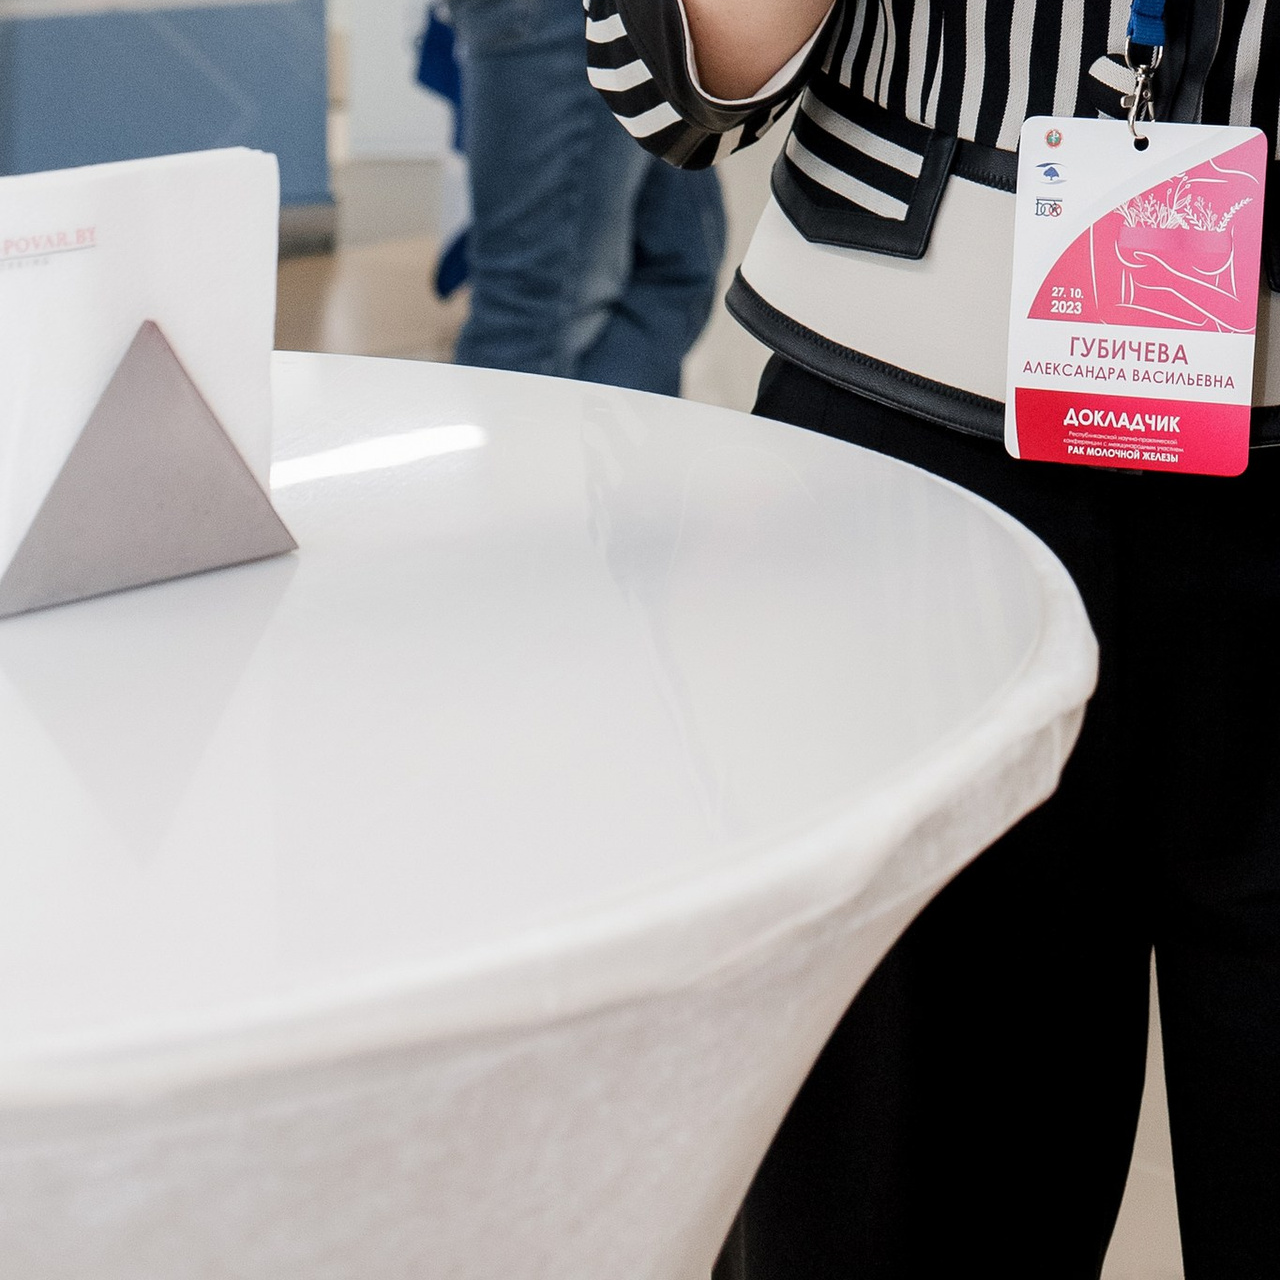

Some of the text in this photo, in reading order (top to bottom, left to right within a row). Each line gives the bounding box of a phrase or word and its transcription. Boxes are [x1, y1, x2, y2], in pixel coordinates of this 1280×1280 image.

[1051, 286, 1084, 299] 27. 10.
[1050, 300, 1082, 315] 2023
[1069, 336, 1189, 365] ГУБИЧЕВА
[1022, 360, 1235, 389] АЛЕКСАНДРА ВАСИЛЬЕВНА
[1063, 407, 1181, 433] ДОКЛАДЧИК
[1068, 430, 1117, 440] Республиканской
[1067, 445, 1179, 463] РАК МОЛОЧНОЙ ЖЕЛЕЗЫ
